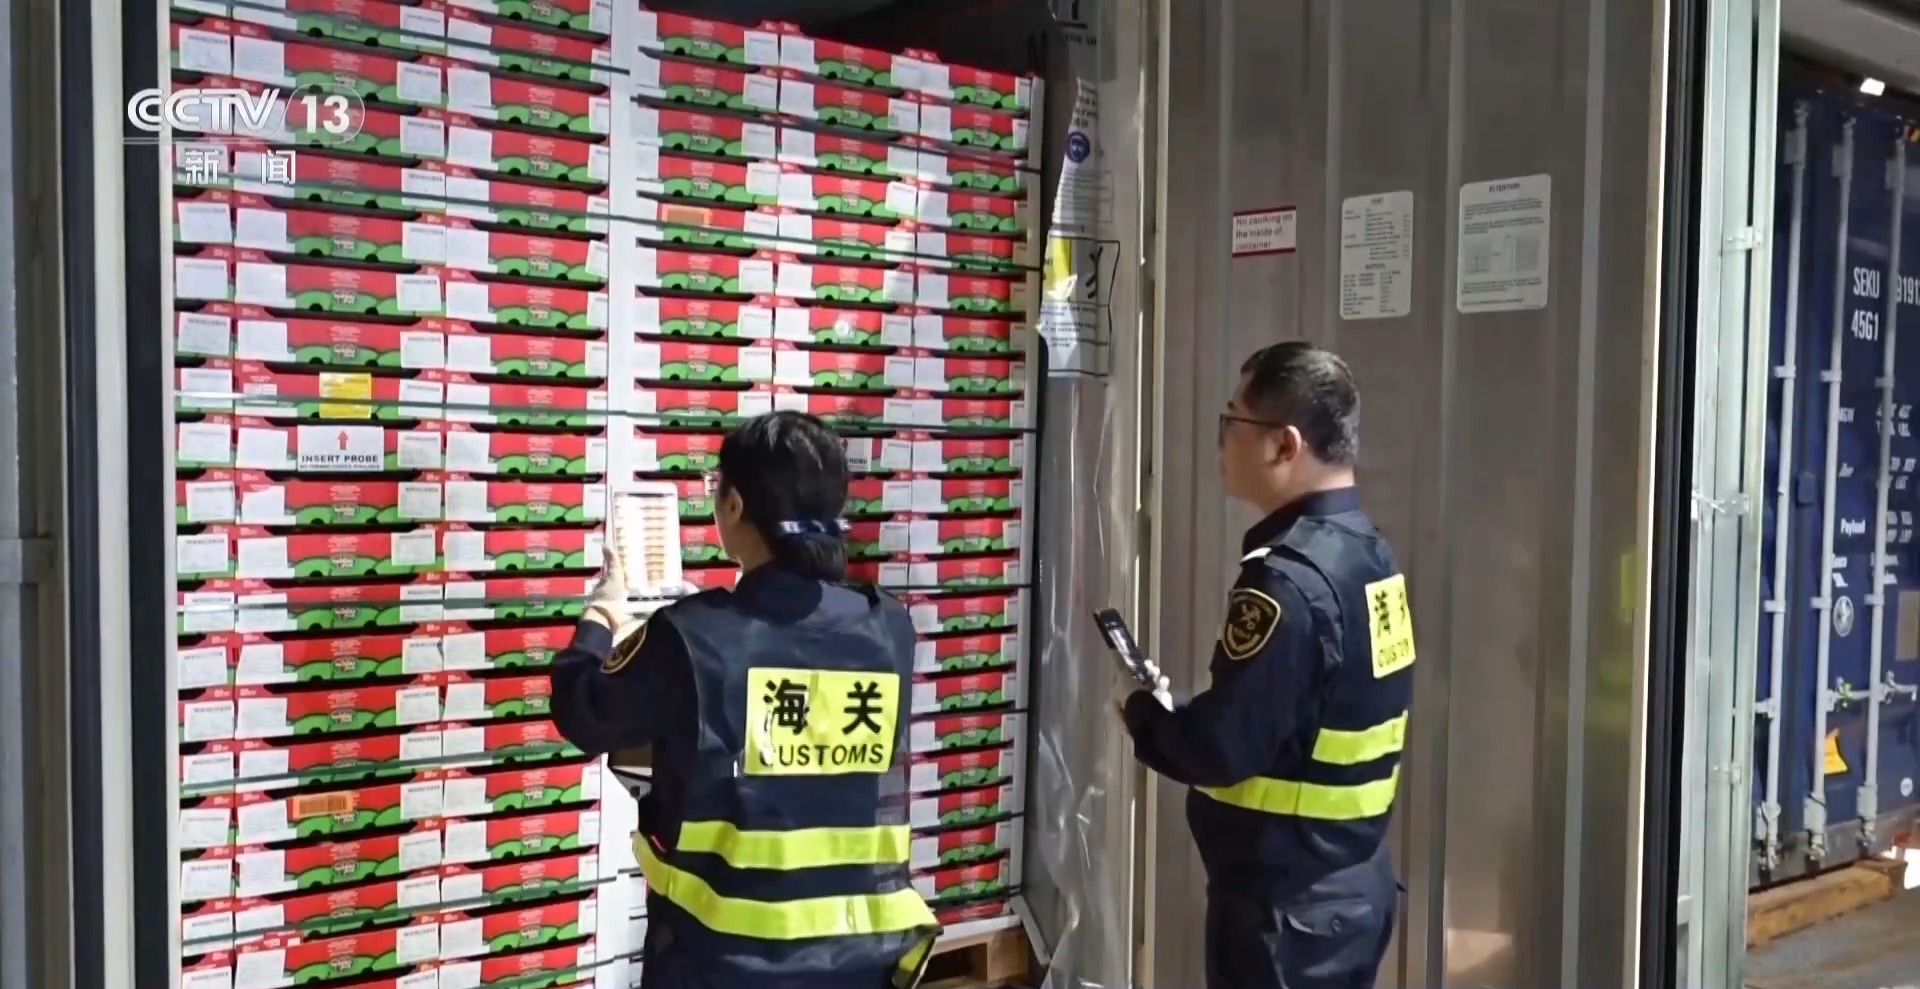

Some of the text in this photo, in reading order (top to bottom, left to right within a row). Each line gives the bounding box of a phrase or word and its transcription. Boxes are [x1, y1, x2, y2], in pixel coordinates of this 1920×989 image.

[1283, 213, 1293, 221] on
[1236, 229, 1248, 239] the
[1274, 225, 1283, 235] of
[1853, 266, 1880, 299] SEKU
[1851, 308, 1879, 341] 45G1
[301, 454, 379, 463] INSERT PROBE
[763, 678, 883, 735] 海关
